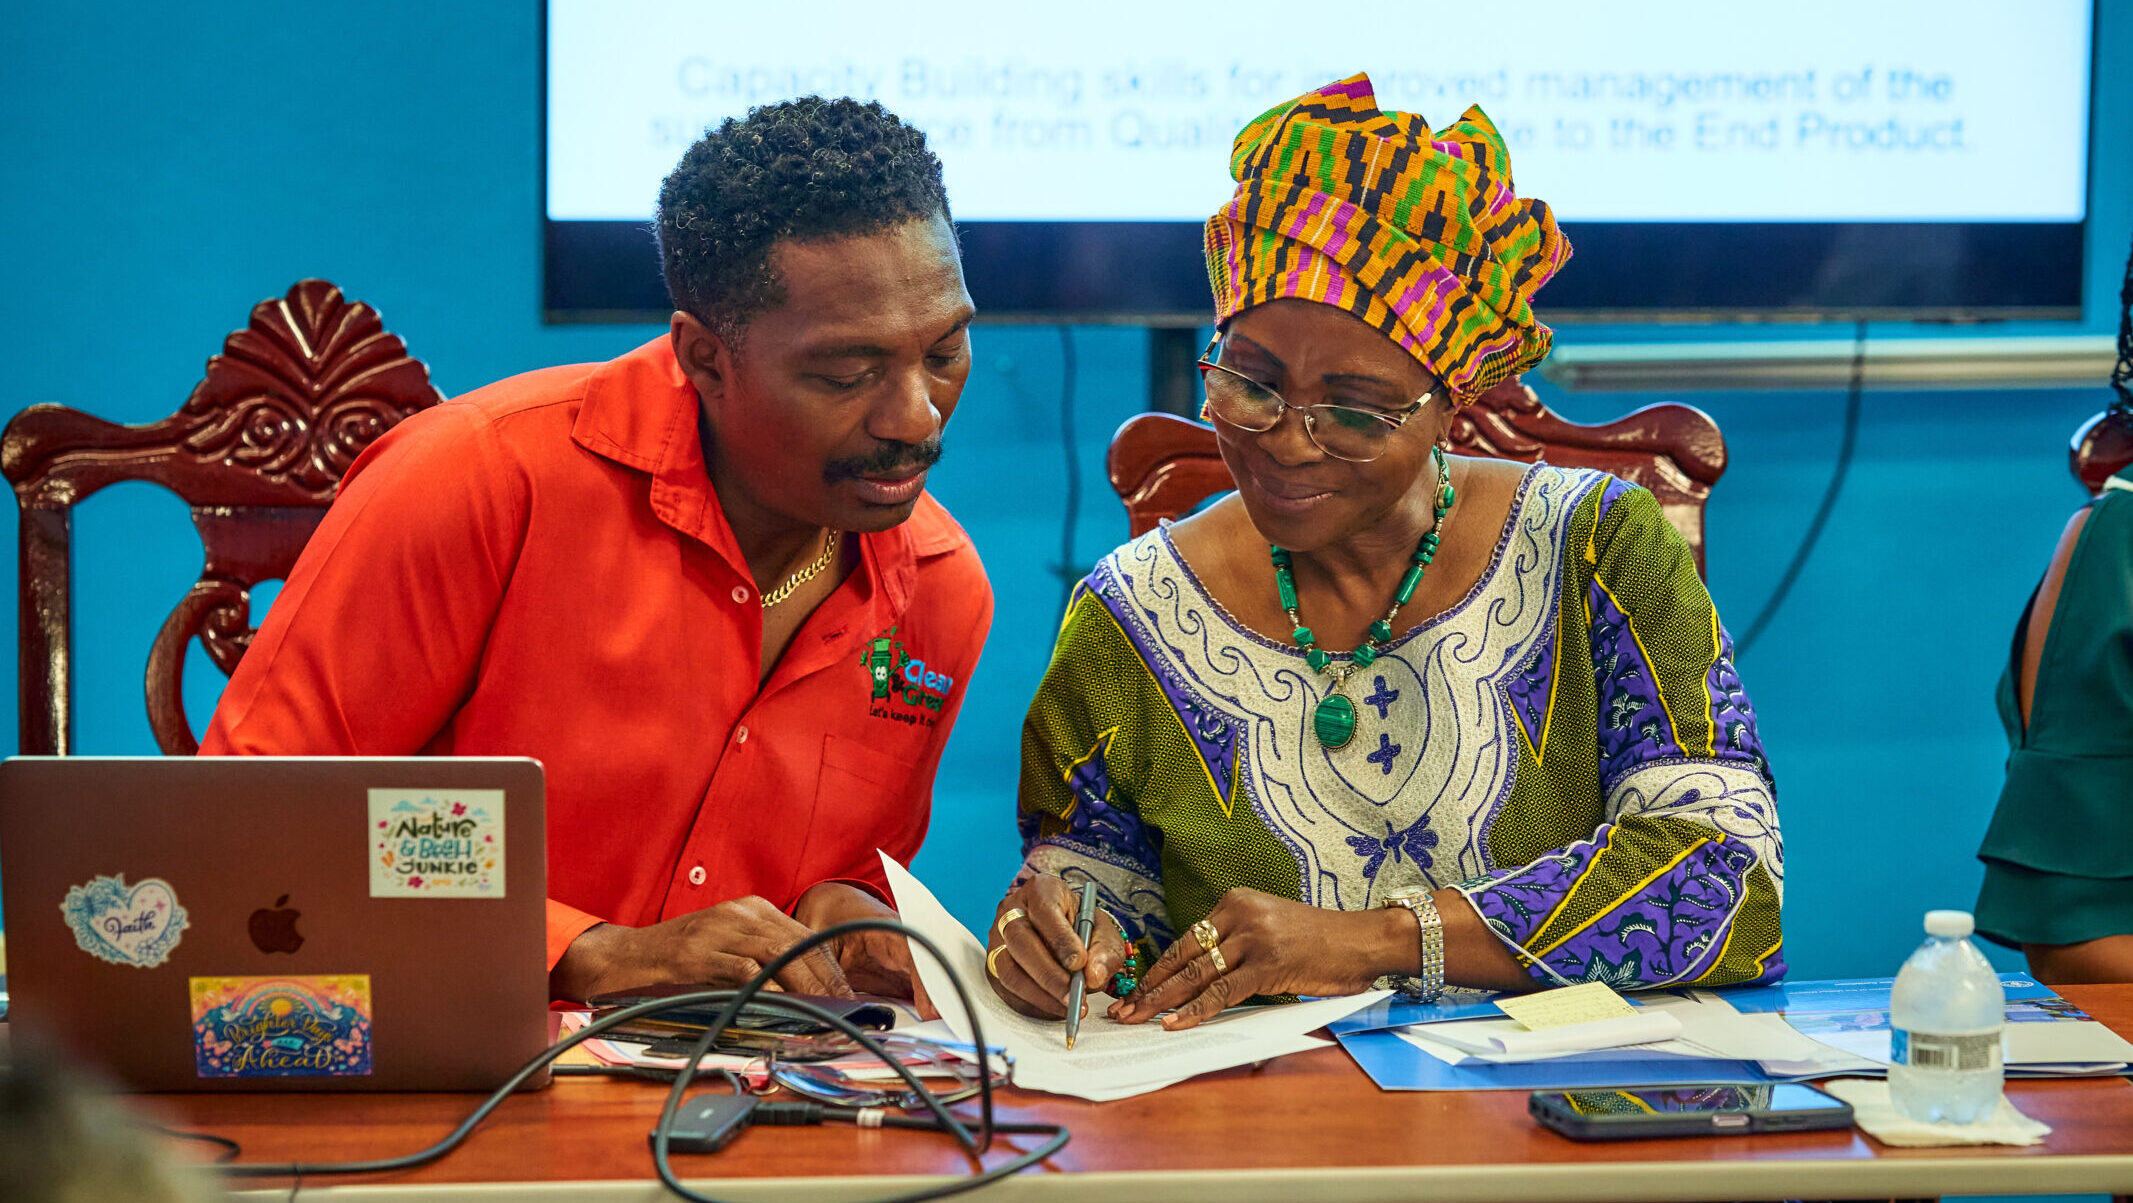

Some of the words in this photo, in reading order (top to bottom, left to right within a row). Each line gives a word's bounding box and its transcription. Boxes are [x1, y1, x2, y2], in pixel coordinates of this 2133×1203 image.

[677, 53, 888, 105] Capacity
[899, 53, 1084, 110] Building
[1099, 54, 1211, 100] skills
[1226, 54, 1285, 99] for
[1529, 66, 1817, 108] management
[1832, 62, 1875, 101] of
[1887, 64, 1954, 101] the
[990, 107, 1094, 149] from
[1554, 115, 1595, 150] to
[1610, 112, 1675, 149] the
[1694, 110, 1779, 150] End
[890, 708, 917, 726] keep
[395, 811, 478, 838] Nature
[400, 839, 416, 857] &
[103, 910, 157, 942] Faith
[223, 1012, 296, 1043] Brighter
